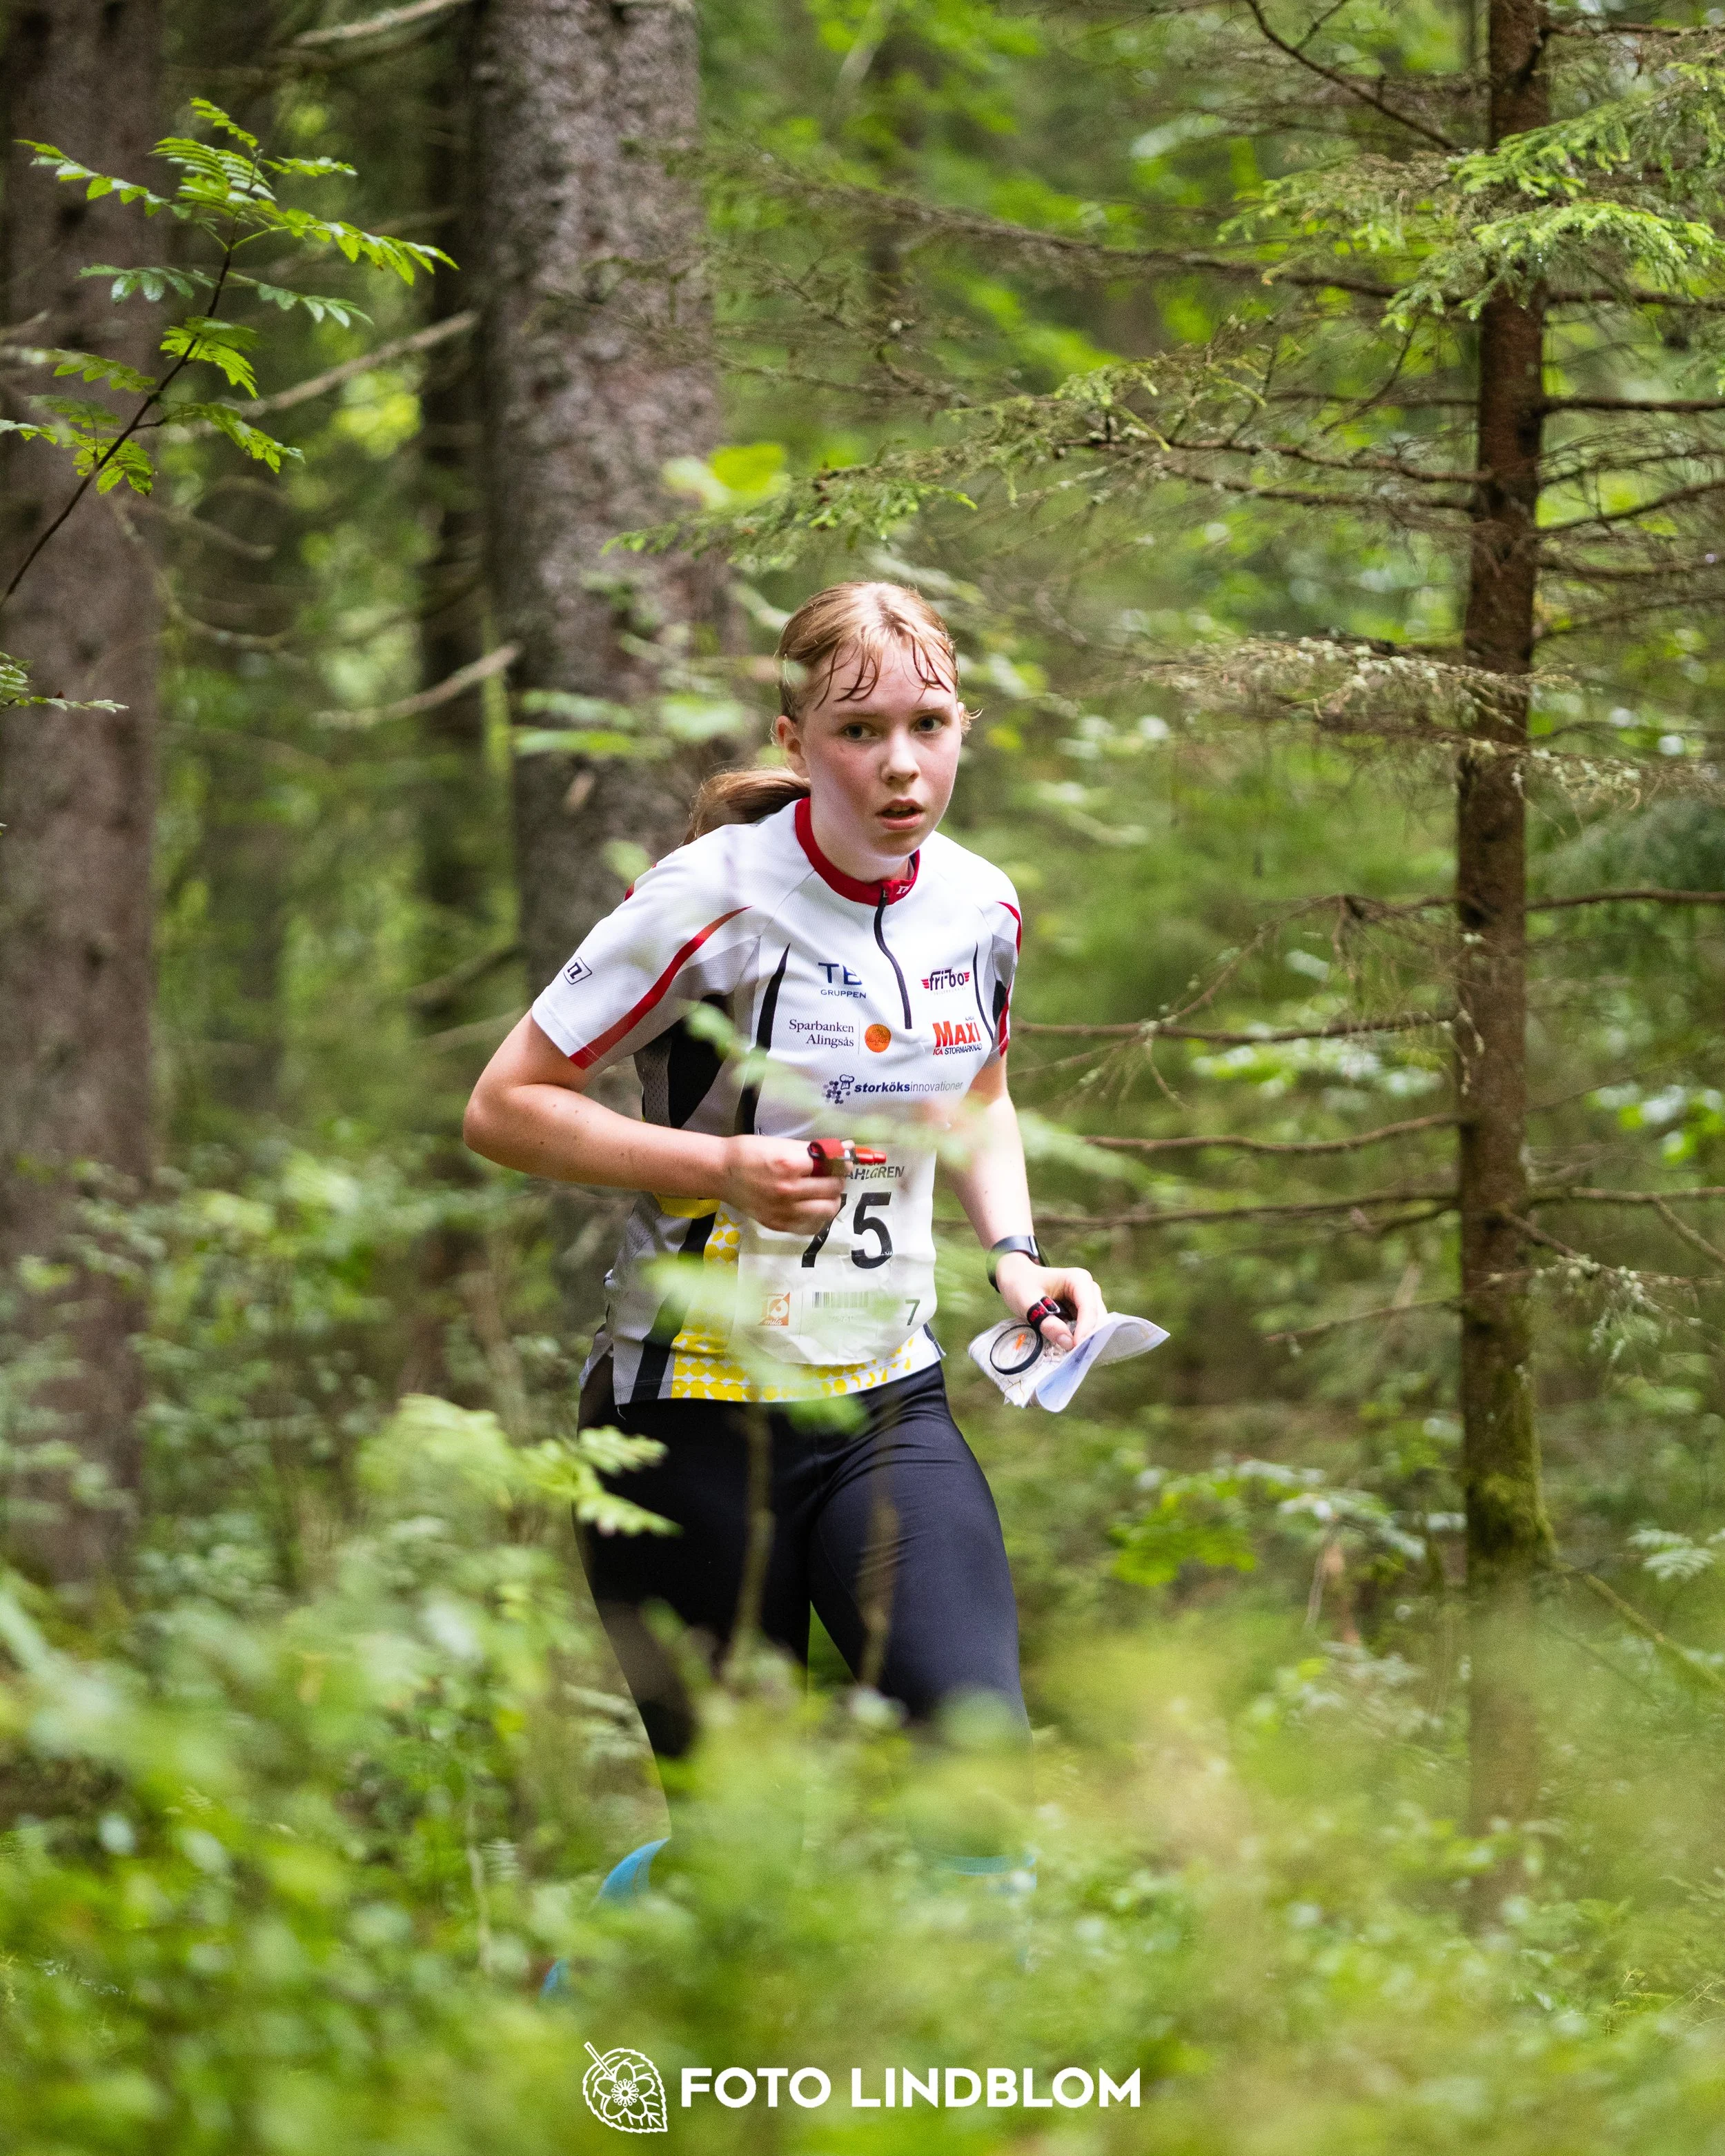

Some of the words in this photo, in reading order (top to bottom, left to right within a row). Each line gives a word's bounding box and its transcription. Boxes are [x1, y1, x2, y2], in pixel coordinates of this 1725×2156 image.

[820, 989, 867, 998] GRUPPEN
[789, 1019, 854, 1033] Sparbanken
[806, 1034, 854, 1049] Alingsås
[945, 1043, 983, 1055] STORMARKNAD
[854, 1081, 963, 1092] storköksinnovationer
[905, 1299, 920, 1326] 7
